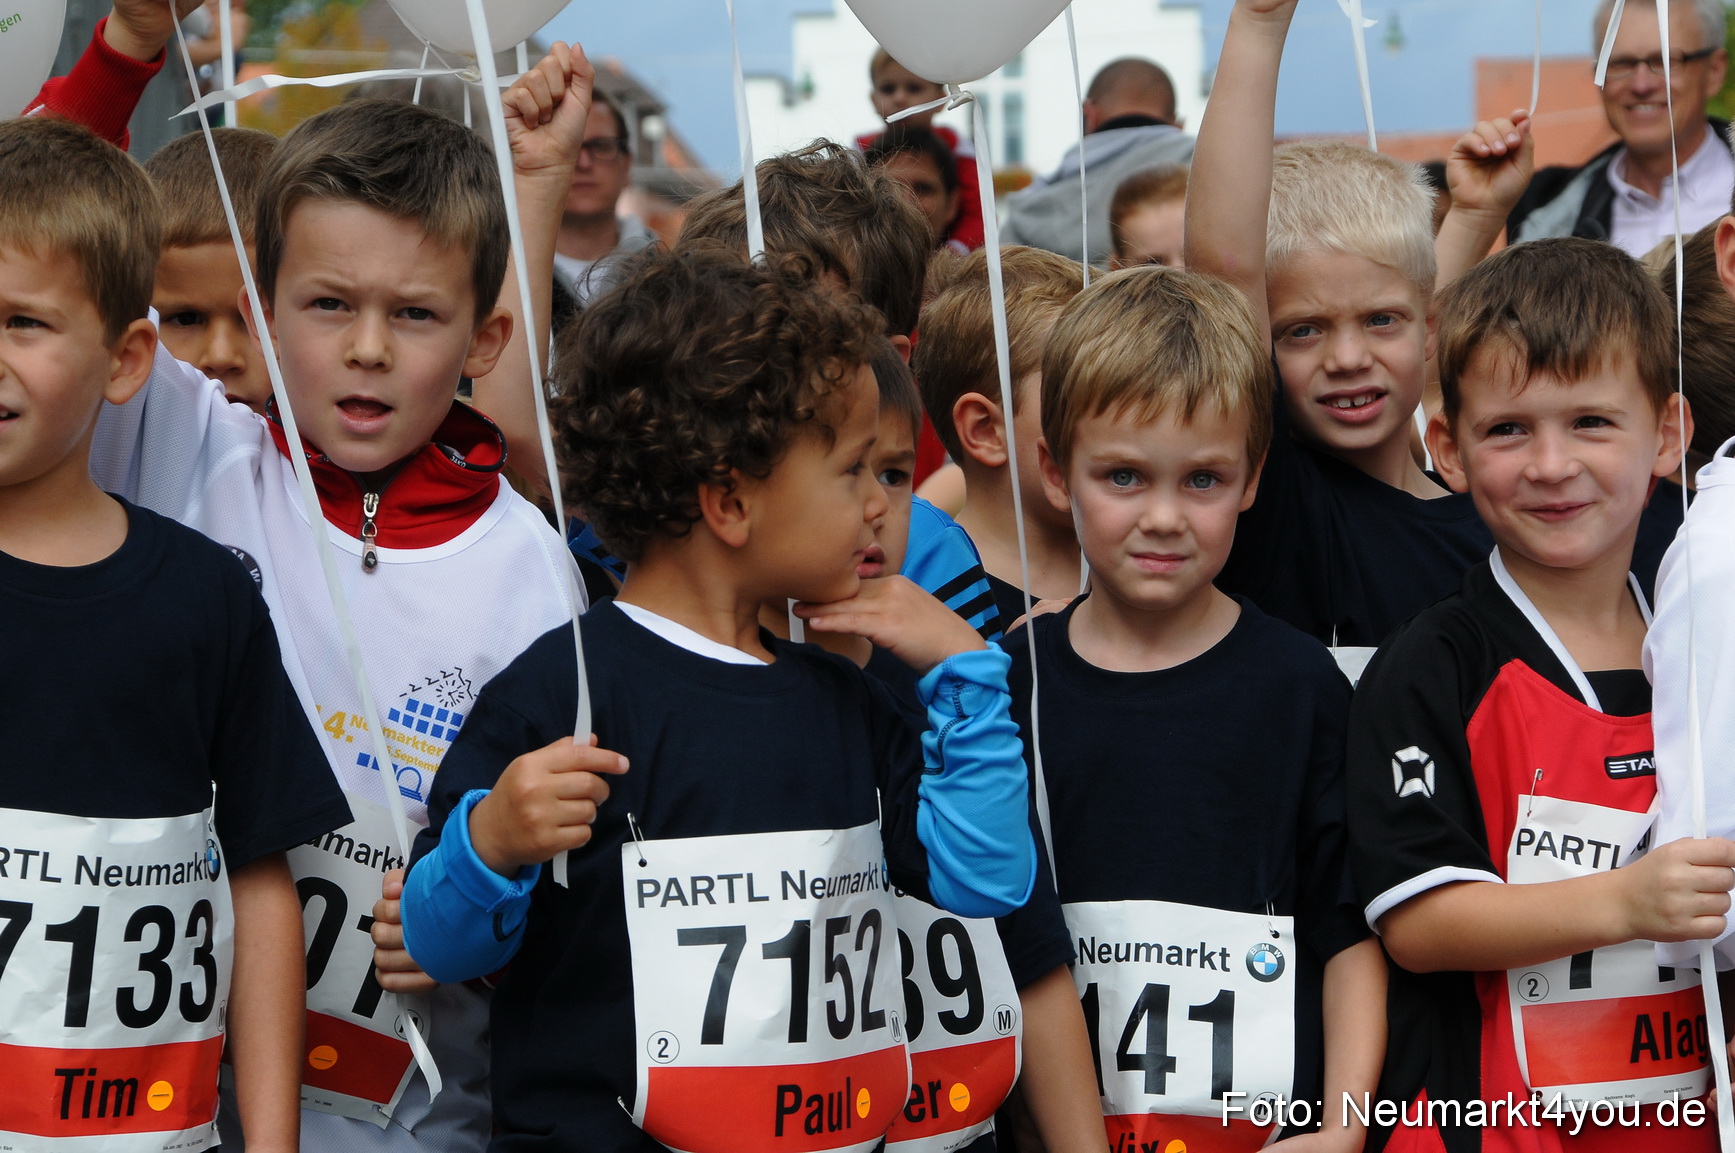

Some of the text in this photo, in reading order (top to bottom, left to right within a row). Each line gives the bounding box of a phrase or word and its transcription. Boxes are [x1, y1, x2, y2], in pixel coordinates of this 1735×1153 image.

[75, 850, 208, 887] Neumarkt
[637, 862, 879, 908] PARTL Neumarkt
[1078, 936, 1231, 973] Neumarkt
[676, 908, 886, 1045] 7152
[1527, 978, 1540, 997] 2
[891, 1016, 901, 1037] M
[998, 1009, 1011, 1030] M
[656, 1037, 669, 1058] 2
[54, 1068, 139, 1120] Tim
[775, 1077, 851, 1137] Paul
